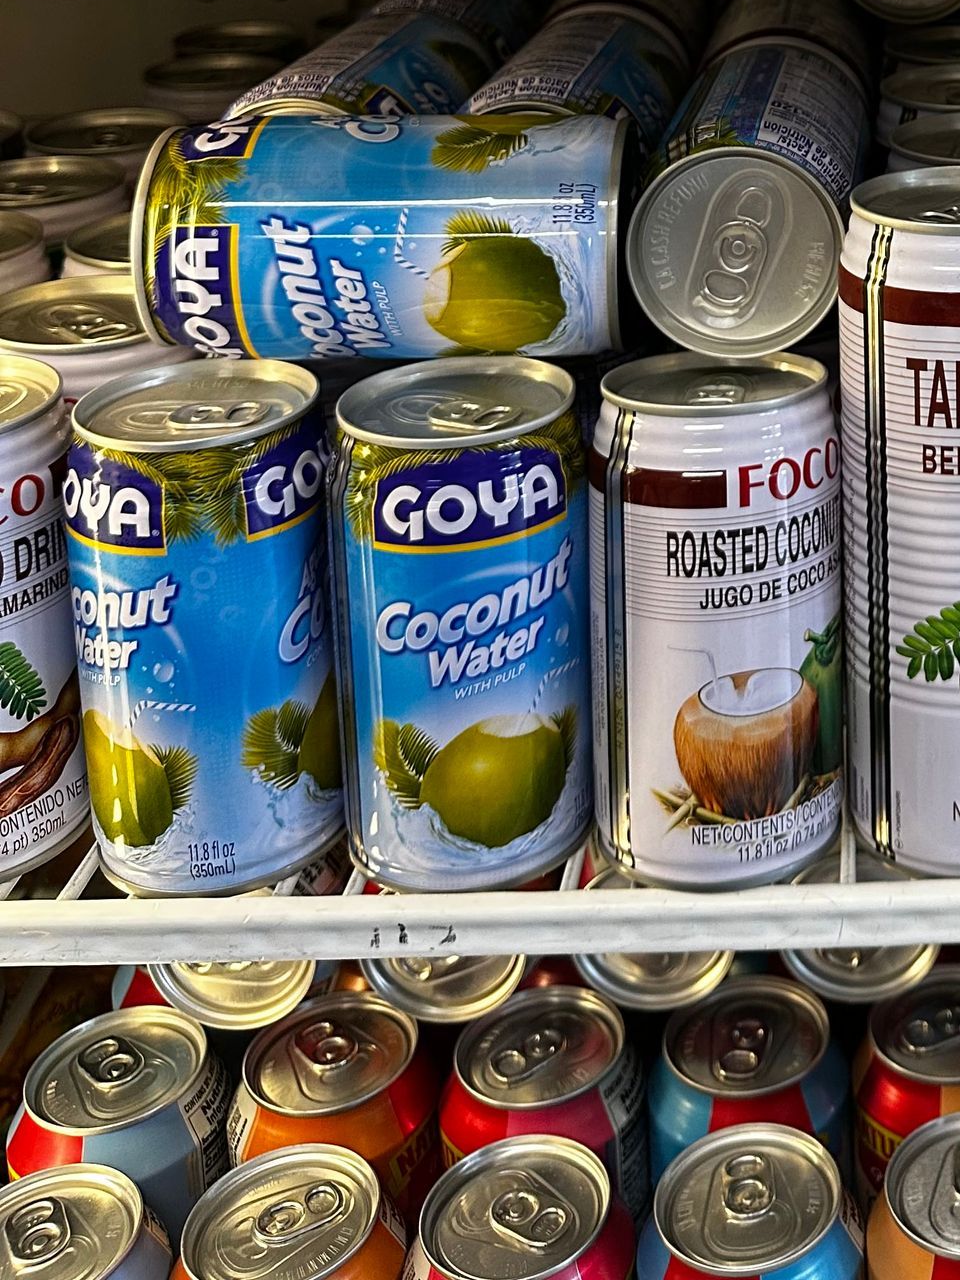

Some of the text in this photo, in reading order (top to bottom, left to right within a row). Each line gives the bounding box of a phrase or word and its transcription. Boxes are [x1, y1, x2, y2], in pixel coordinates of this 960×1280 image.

[552, 183, 574, 224] 11.8 oz
[573, 183, 598, 224] (350mL)
[174, 235, 244, 359] OYA
[260, 217, 357, 359] oconut
[329, 259, 391, 348] Water
[371, 280, 402, 336] WITH PULP
[63, 467, 151, 538] OYA
[382, 463, 559, 542] GOYA
[738, 438, 839, 508] FOCO
[666, 495, 841, 578] ROASTED COCONUT
[72, 575, 177, 629] conut
[376, 537, 572, 653] Coconut
[700, 561, 825, 609] JUGO DE COCO
[428, 616, 545, 688] Water
[454, 663, 526, 701] WITH PULP
[13, 810, 66, 854] pt) 350mL
[188, 841, 236, 862] 11.8 fl oz
[189, 860, 236, 880] (350mL)
